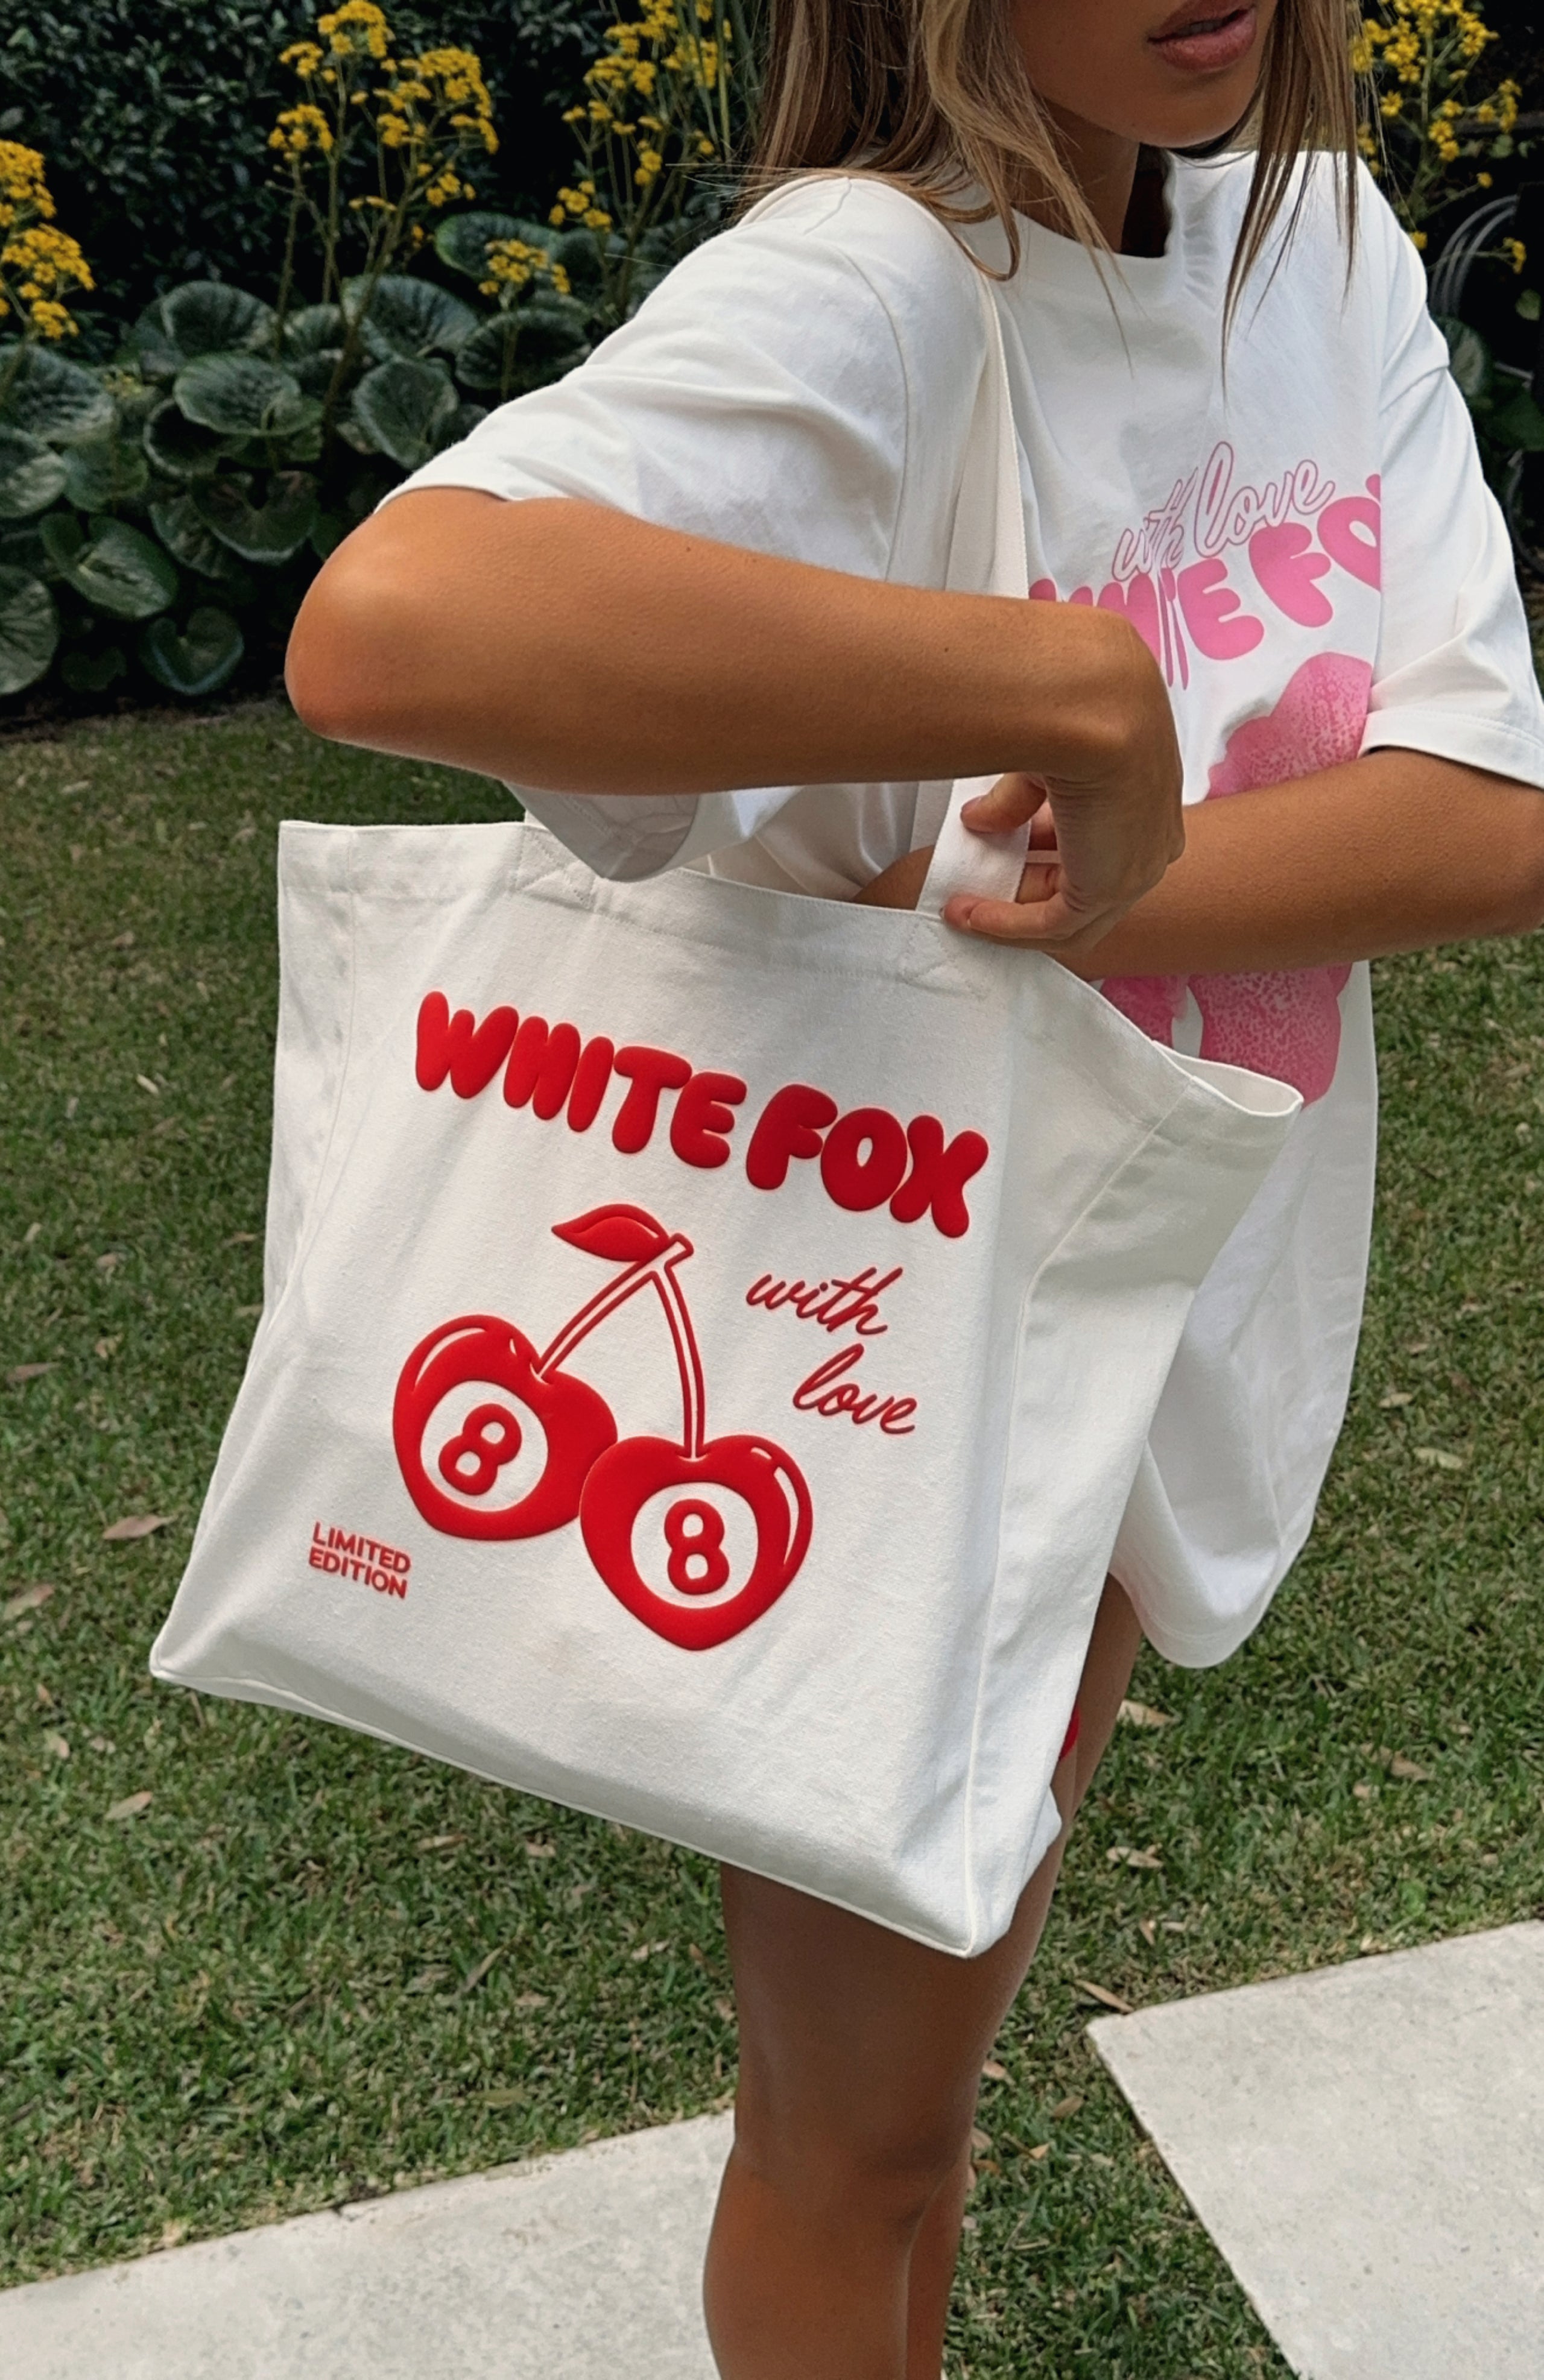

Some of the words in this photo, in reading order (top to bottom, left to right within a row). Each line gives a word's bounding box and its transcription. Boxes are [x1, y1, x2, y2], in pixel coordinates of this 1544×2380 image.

[1194, 441, 1336, 558] love
[1248, 473, 1381, 628] FO
[415, 990, 748, 1169] WHITE
[745, 1084, 990, 1239] FOX
[746, 1266, 903, 1336] with
[793, 1342, 917, 1434] love
[437, 1402, 524, 1497] 8
[308, 1545, 408, 1600] EDITION
[312, 1521, 411, 1573] LIMITED
[663, 1497, 731, 1597] 8
